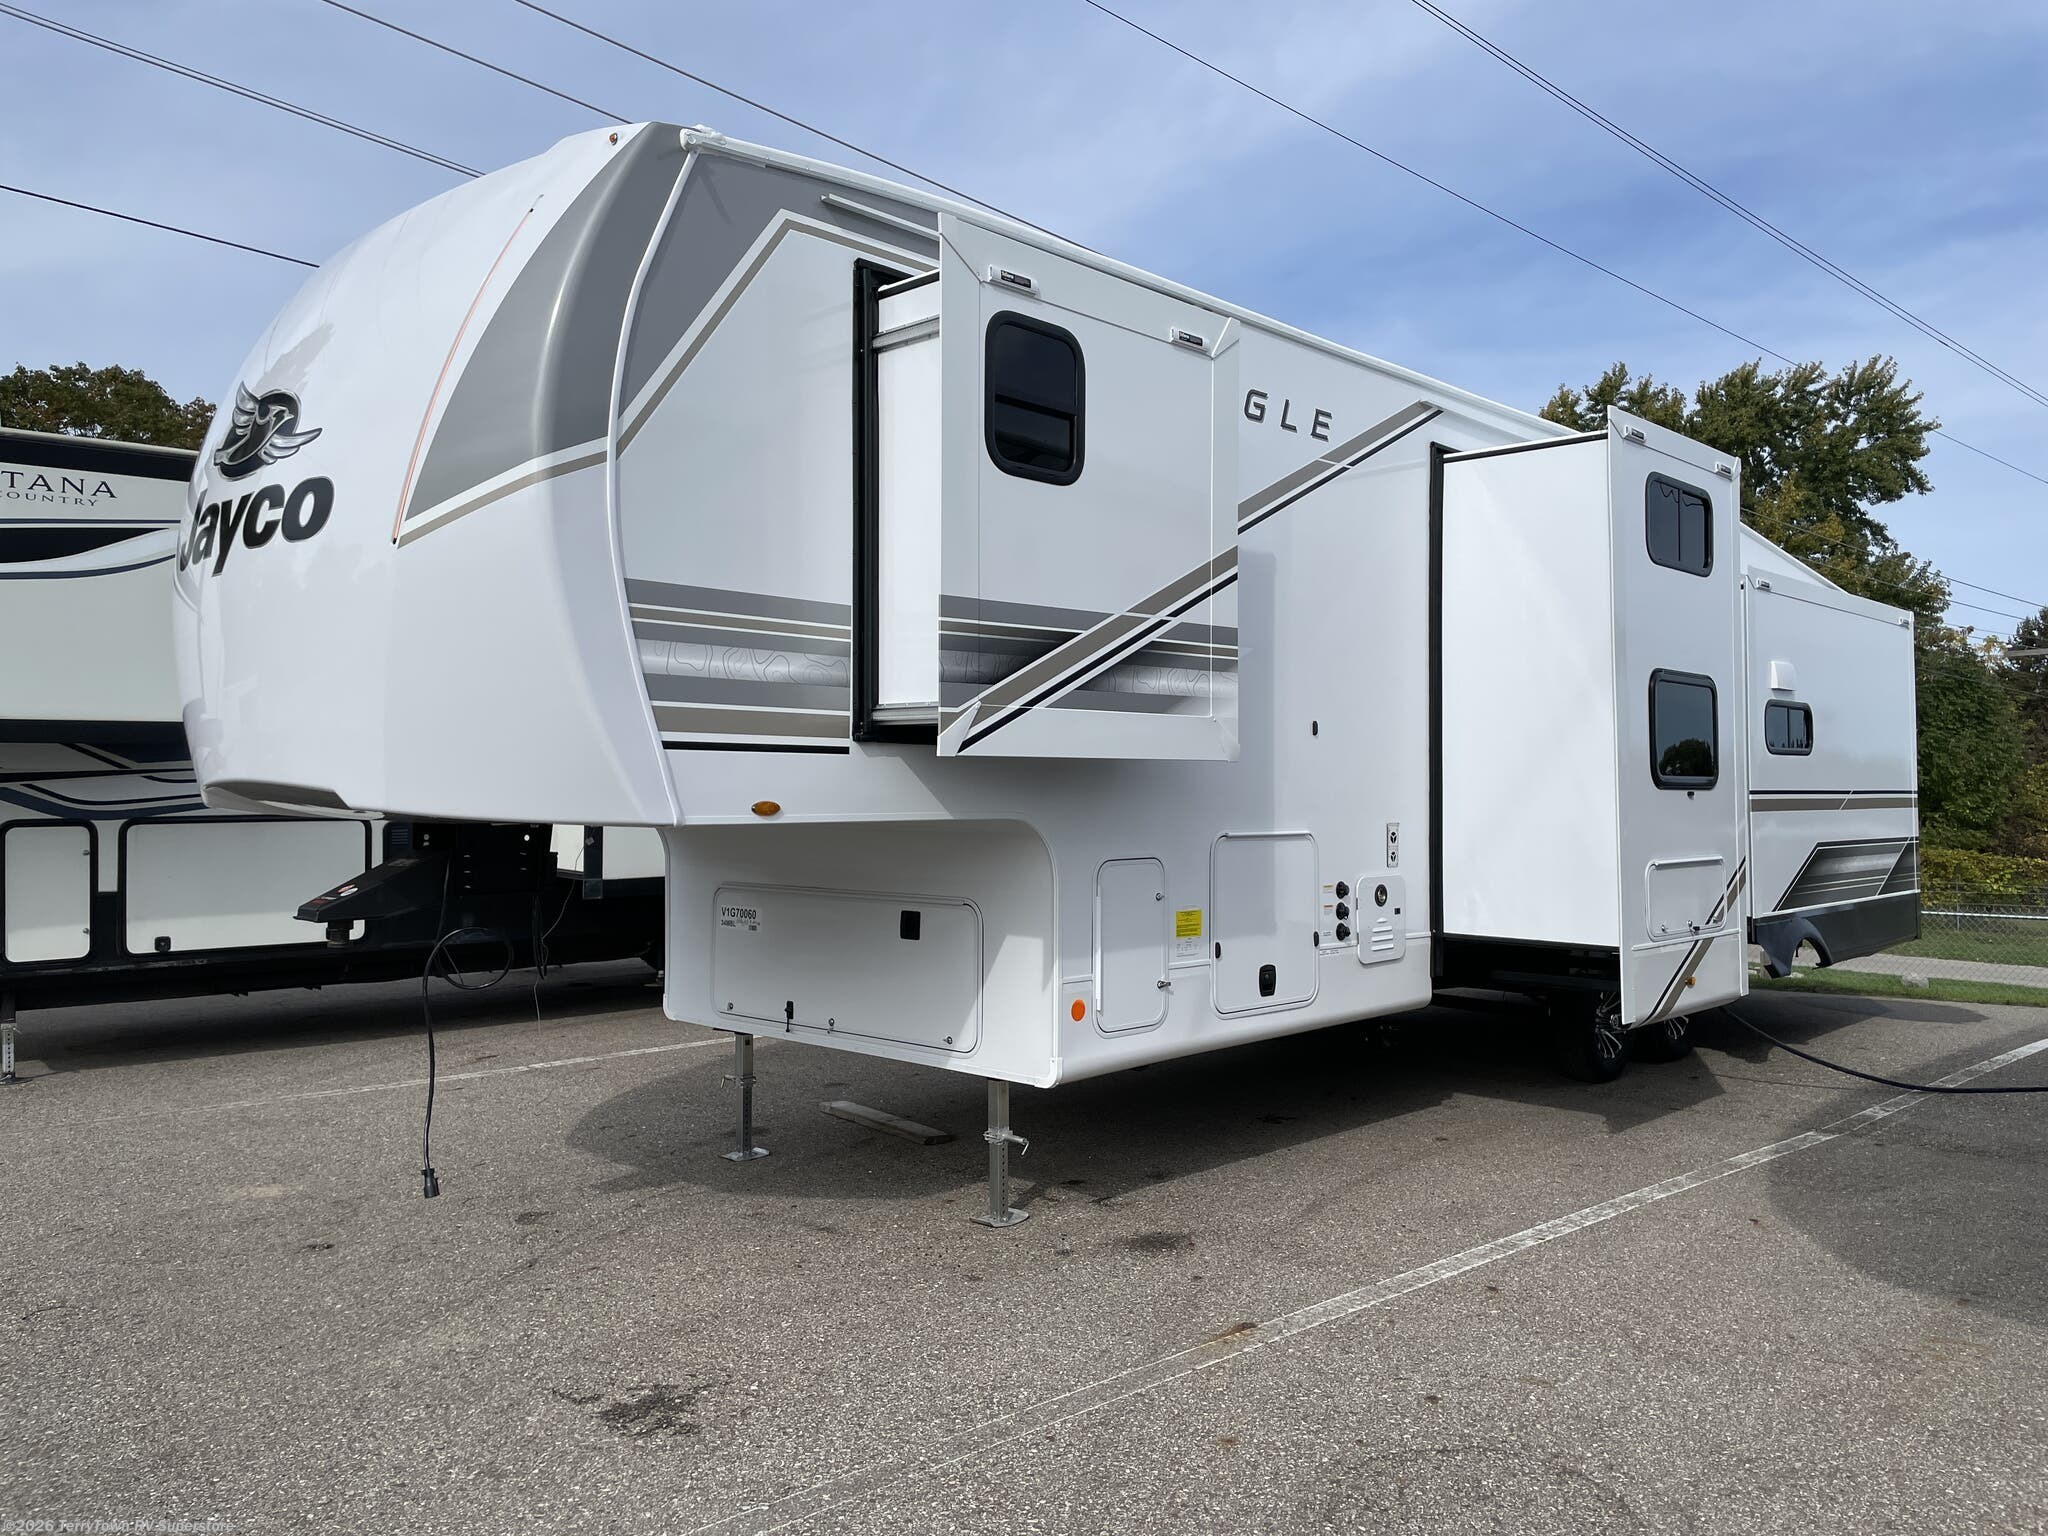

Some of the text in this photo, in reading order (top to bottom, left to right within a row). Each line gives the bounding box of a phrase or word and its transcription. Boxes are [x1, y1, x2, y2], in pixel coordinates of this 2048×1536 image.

[1244, 388, 1333, 442] GLE
[1, 470, 118, 498] TANA
[0, 490, 97, 507] OUNTRY
[180, 475, 335, 577] Jayco
[721, 906, 757, 920] V1G70060
